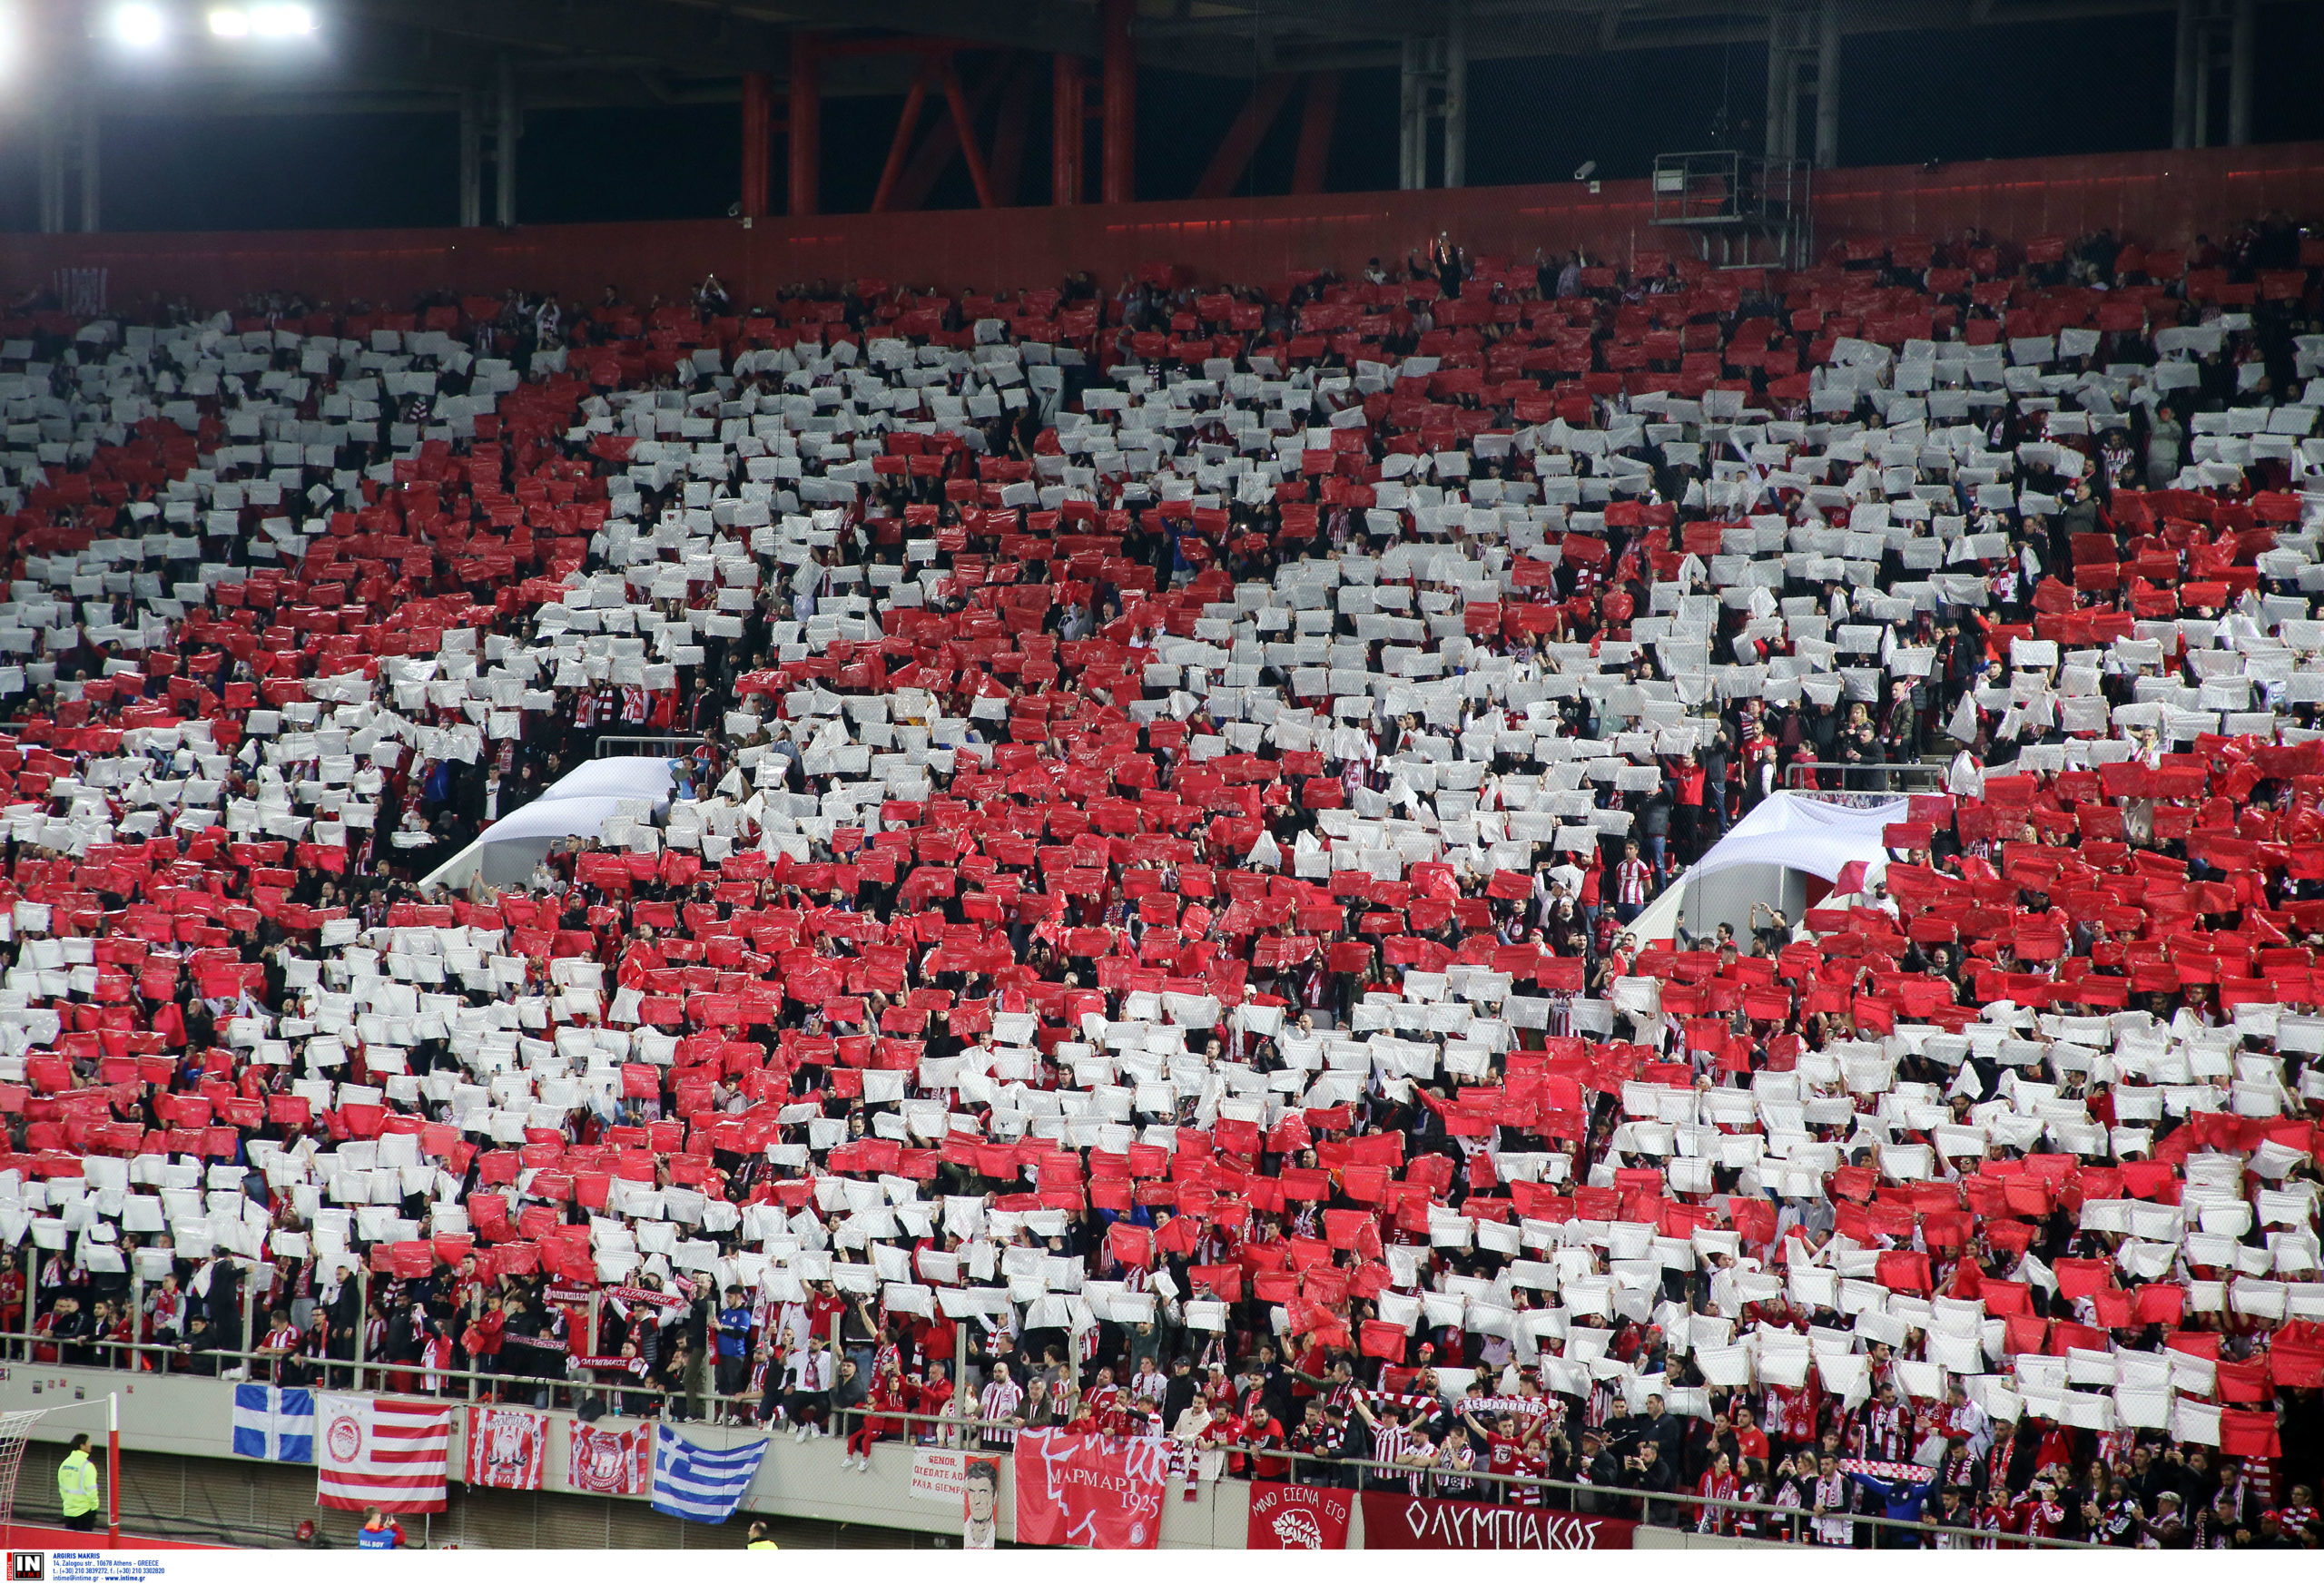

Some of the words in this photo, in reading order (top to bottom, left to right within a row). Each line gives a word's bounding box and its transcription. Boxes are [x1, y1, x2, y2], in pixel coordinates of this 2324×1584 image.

[551, 1290, 590, 1302] ΟΛΥΜΠΙΑΚΟ
[912, 1478, 932, 1491] PARA
[1119, 1491, 1160, 1520] 1925
[1284, 1487, 1319, 1509] ΕΣΕΝΑ
[1405, 1500, 1603, 1550] ΟΛΥΜΠΙΑΚΟΣ
